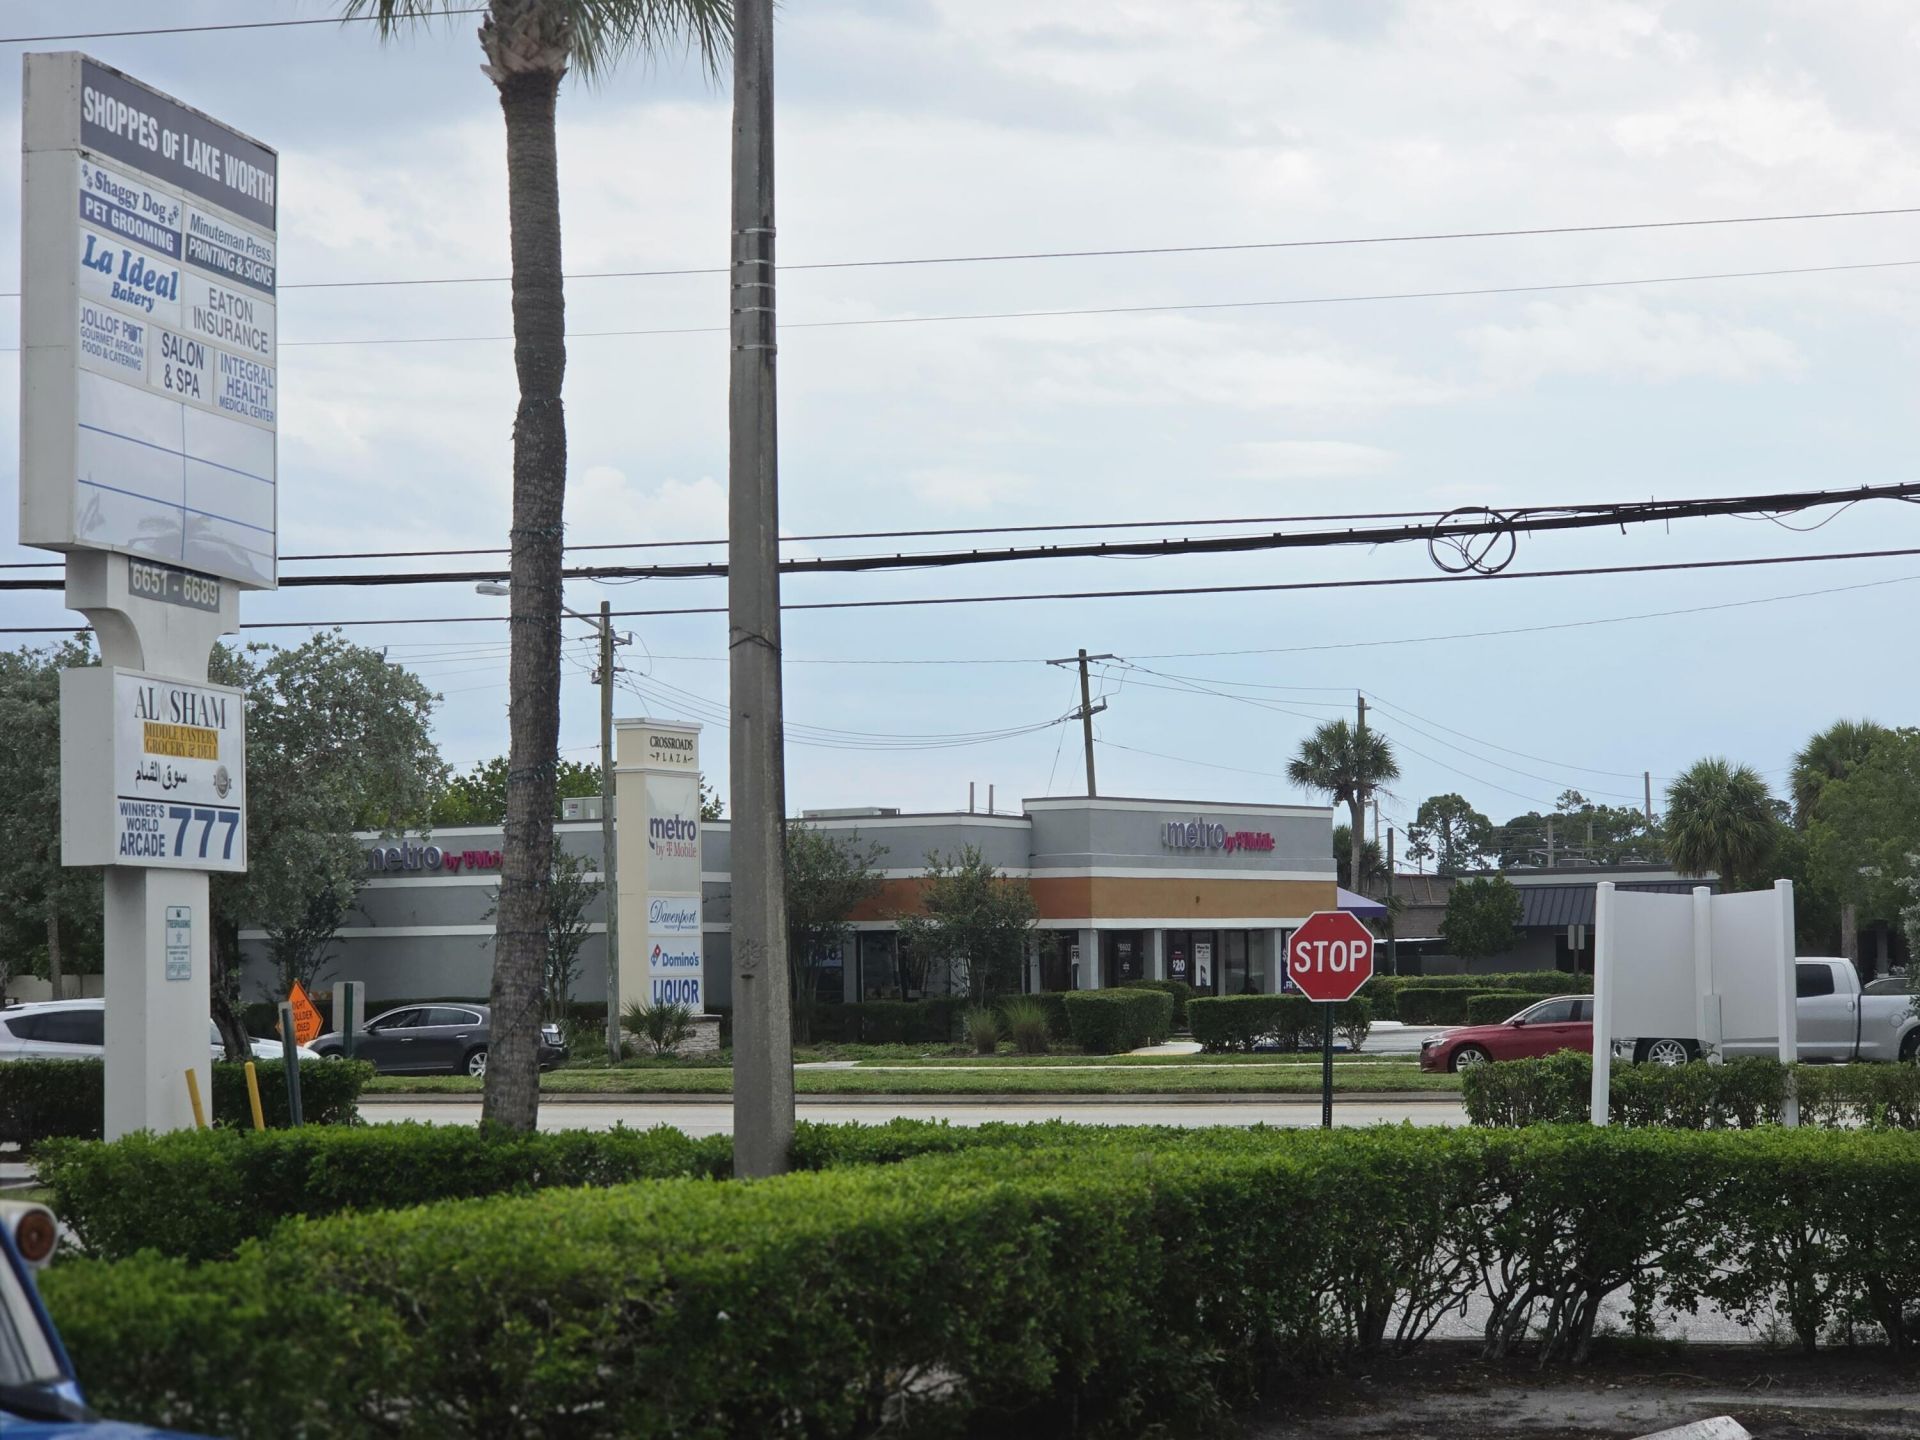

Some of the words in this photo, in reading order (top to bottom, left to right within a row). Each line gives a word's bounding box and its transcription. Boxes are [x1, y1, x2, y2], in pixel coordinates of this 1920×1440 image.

[83, 86, 159, 151] SHOPPES
[162, 128, 179, 160] OF
[183, 133, 220, 182] LAKE
[224, 153, 273, 207] WORTH
[95, 170, 139, 210] Shaggy
[142, 191, 166, 223] Dog
[85, 197, 108, 222] PET
[111, 209, 174, 252] GROOMING
[190, 213, 244, 252] Minuteman
[246, 236, 271, 262] Press
[82, 235, 114, 274] La
[118, 250, 179, 301] Ideal
[188, 237, 235, 272] PRINTING
[244, 260, 273, 287] SIGNS
[111, 281, 154, 313] Bakery
[209, 287, 253, 324] EATON
[80, 307, 119, 335] JOLLOF
[194, 305, 268, 354] INSURANCE
[80, 326, 114, 348] GOURMET
[115, 339, 144, 359] AFRICAN
[82, 340, 102, 356] FOOD
[109, 349, 142, 371] CATERING
[161, 332, 204, 370] SALON
[164, 363, 173, 389] &
[176, 367, 200, 399] SPA
[220, 352, 274, 389] INTEGRAL
[227, 375, 268, 408] HEALTH
[219, 395, 248, 416] MEDICAL
[249, 404, 274, 422] CENTER
[132, 563, 168, 596] 6651
[183, 575, 217, 607] 6689
[134, 685, 160, 721] AL
[170, 690, 226, 730] SHAM
[144, 722, 177, 740] MIDDLE
[179, 727, 217, 745] EASTERN
[145, 737, 186, 758] GROCERY
[198, 744, 217, 760] DELI
[650, 736, 694, 751] CROSSROADS
[656, 752, 688, 763] PLAZA
[135, 760, 161, 790] الشام
[162, 764, 187, 790] سوق
[120, 802, 165, 818] WINNER'S
[126, 817, 159, 832] WORLD
[169, 806, 239, 860] 777
[650, 814, 697, 842] metro
[1163, 816, 1225, 849] metro
[120, 832, 165, 857] ARCADE
[656, 841, 665, 859] by
[650, 899, 697, 931] Davenport
[662, 952, 699, 967] Domino's
[1294, 940, 1368, 973] STOP
[653, 979, 699, 1004] LIQUOR
